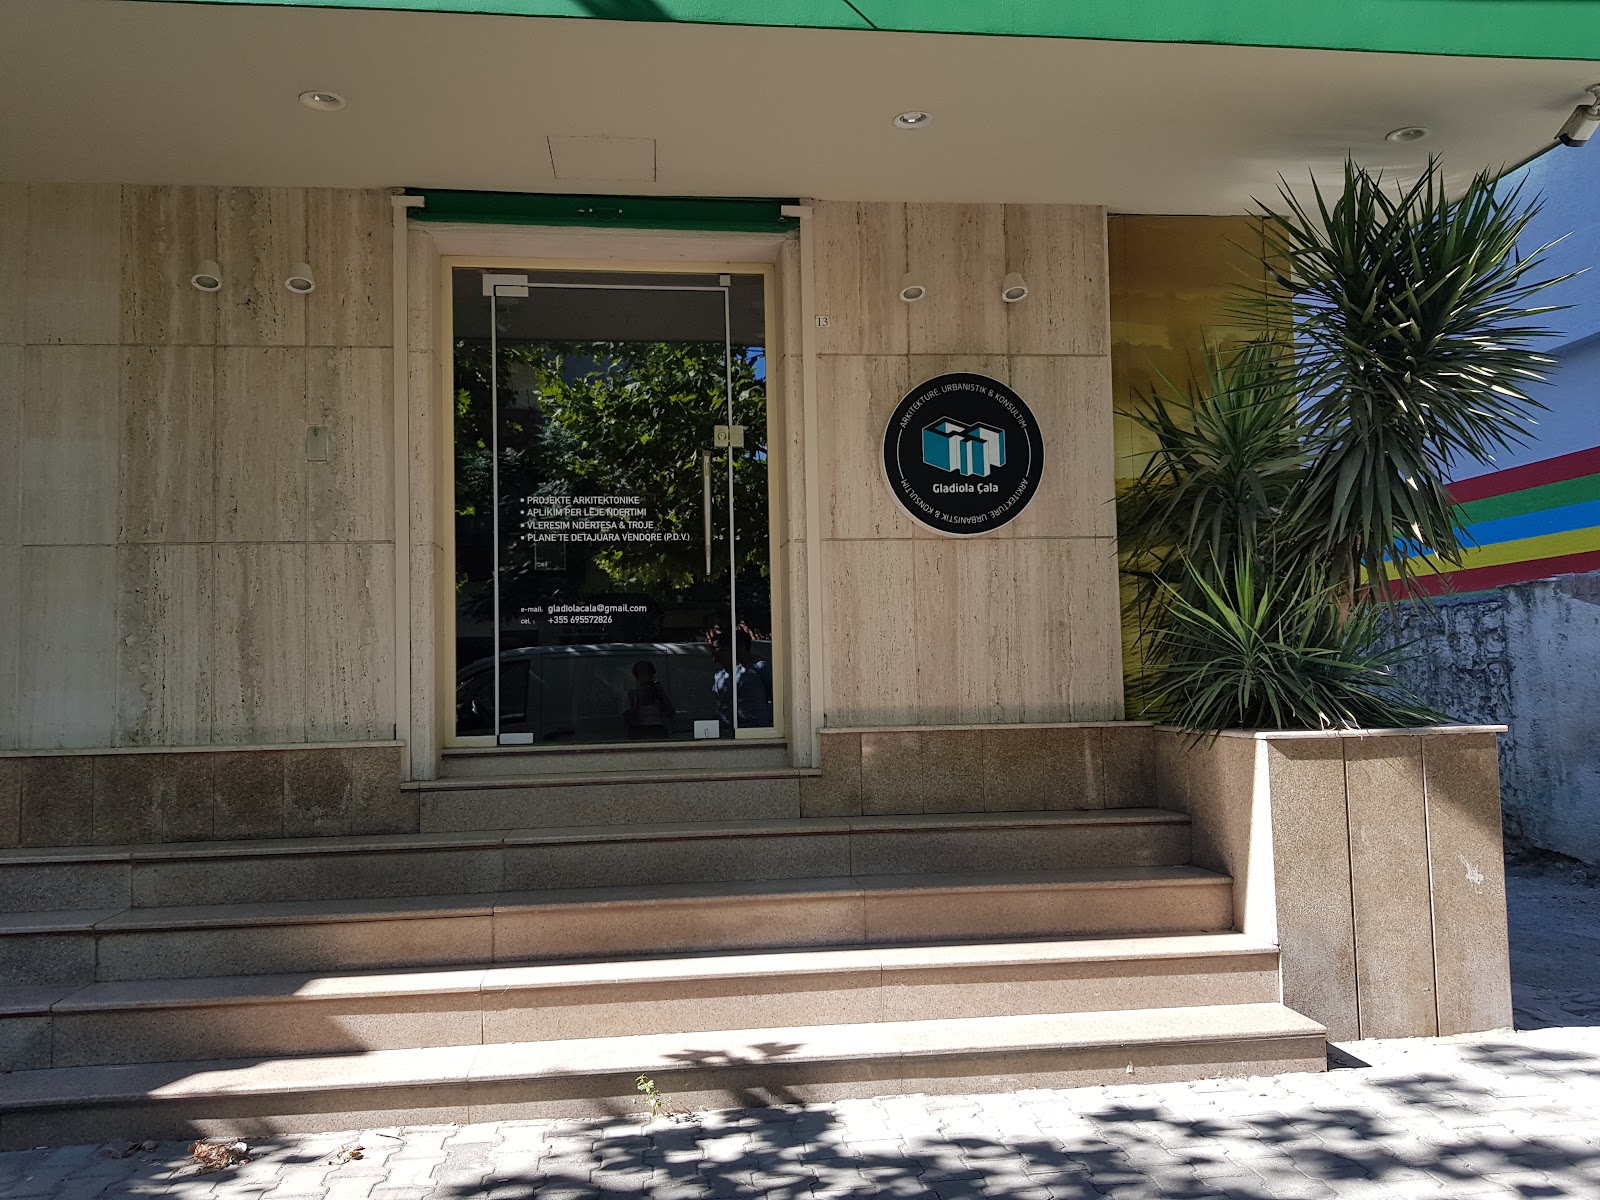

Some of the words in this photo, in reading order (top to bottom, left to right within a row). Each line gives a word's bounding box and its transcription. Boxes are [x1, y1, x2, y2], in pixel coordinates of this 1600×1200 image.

[817, 316, 829, 327] 13
[941, 383, 987, 393] URBANISTIK
[994, 393, 1028, 429] KONSULTIM
[933, 483, 975, 493] Gladiola
[976, 483, 999, 495] Çala
[526, 496, 571, 504] PROJEKTE
[572, 496, 640, 505] ARKITEKTONIKE
[900, 479, 934, 514] KONSULTIM
[526, 508, 563, 516] APLIKIM
[564, 508, 582, 516] PER
[583, 508, 605, 516] LEJE
[606, 508, 647, 516] NDERTIMI
[941, 512, 987, 524] URBANISTIK
[526, 521, 570, 529] VLERESIM
[572, 521, 618, 529] NDERTESA
[619, 521, 626, 529] &
[628, 521, 654, 529] TROJE
[527, 533, 557, 541] PLANE
[559, 533, 570, 541] TE
[571, 533, 620, 541] DETAJUARA
[622, 533, 662, 541] VENDORE
[547, 604, 647, 614] gladiolacala@gmail.com
[547, 615, 568, 624] +355
[570, 615, 613, 624] 695572826
